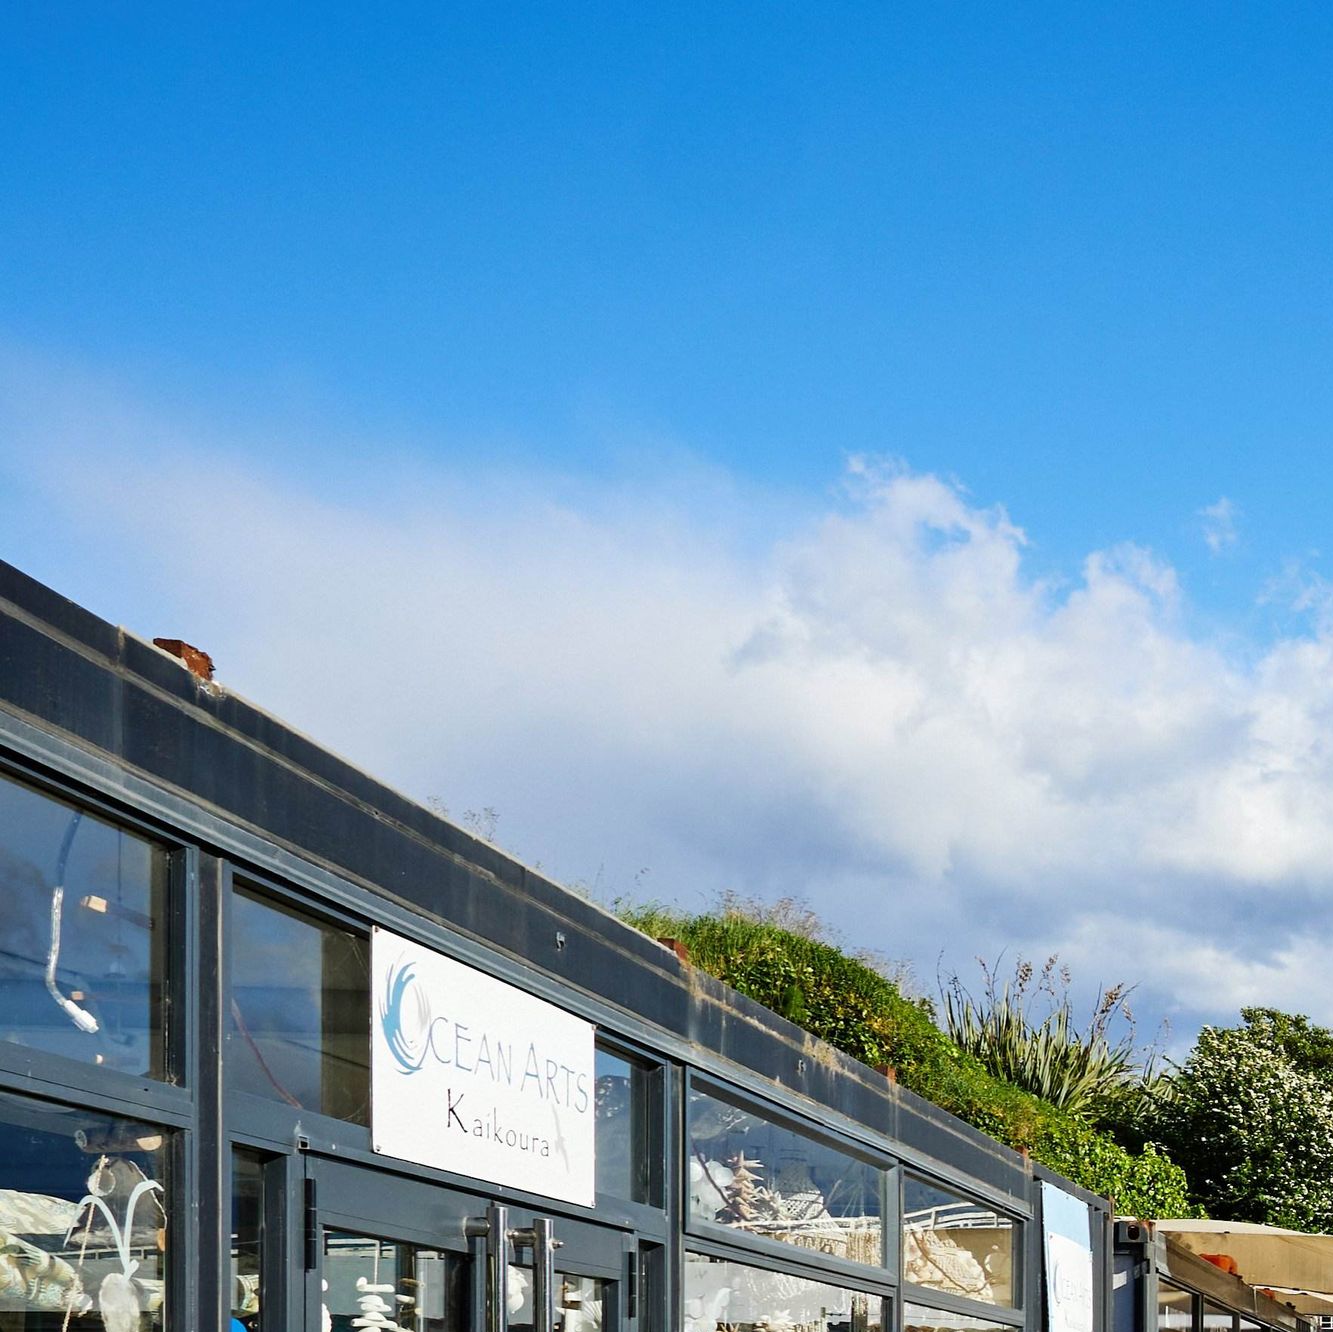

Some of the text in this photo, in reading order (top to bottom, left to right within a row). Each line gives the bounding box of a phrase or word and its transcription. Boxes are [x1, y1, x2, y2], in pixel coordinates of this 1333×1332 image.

[379, 955, 589, 1114] OCEAN ARTS
[447, 1088, 549, 1158] Kaikoura
